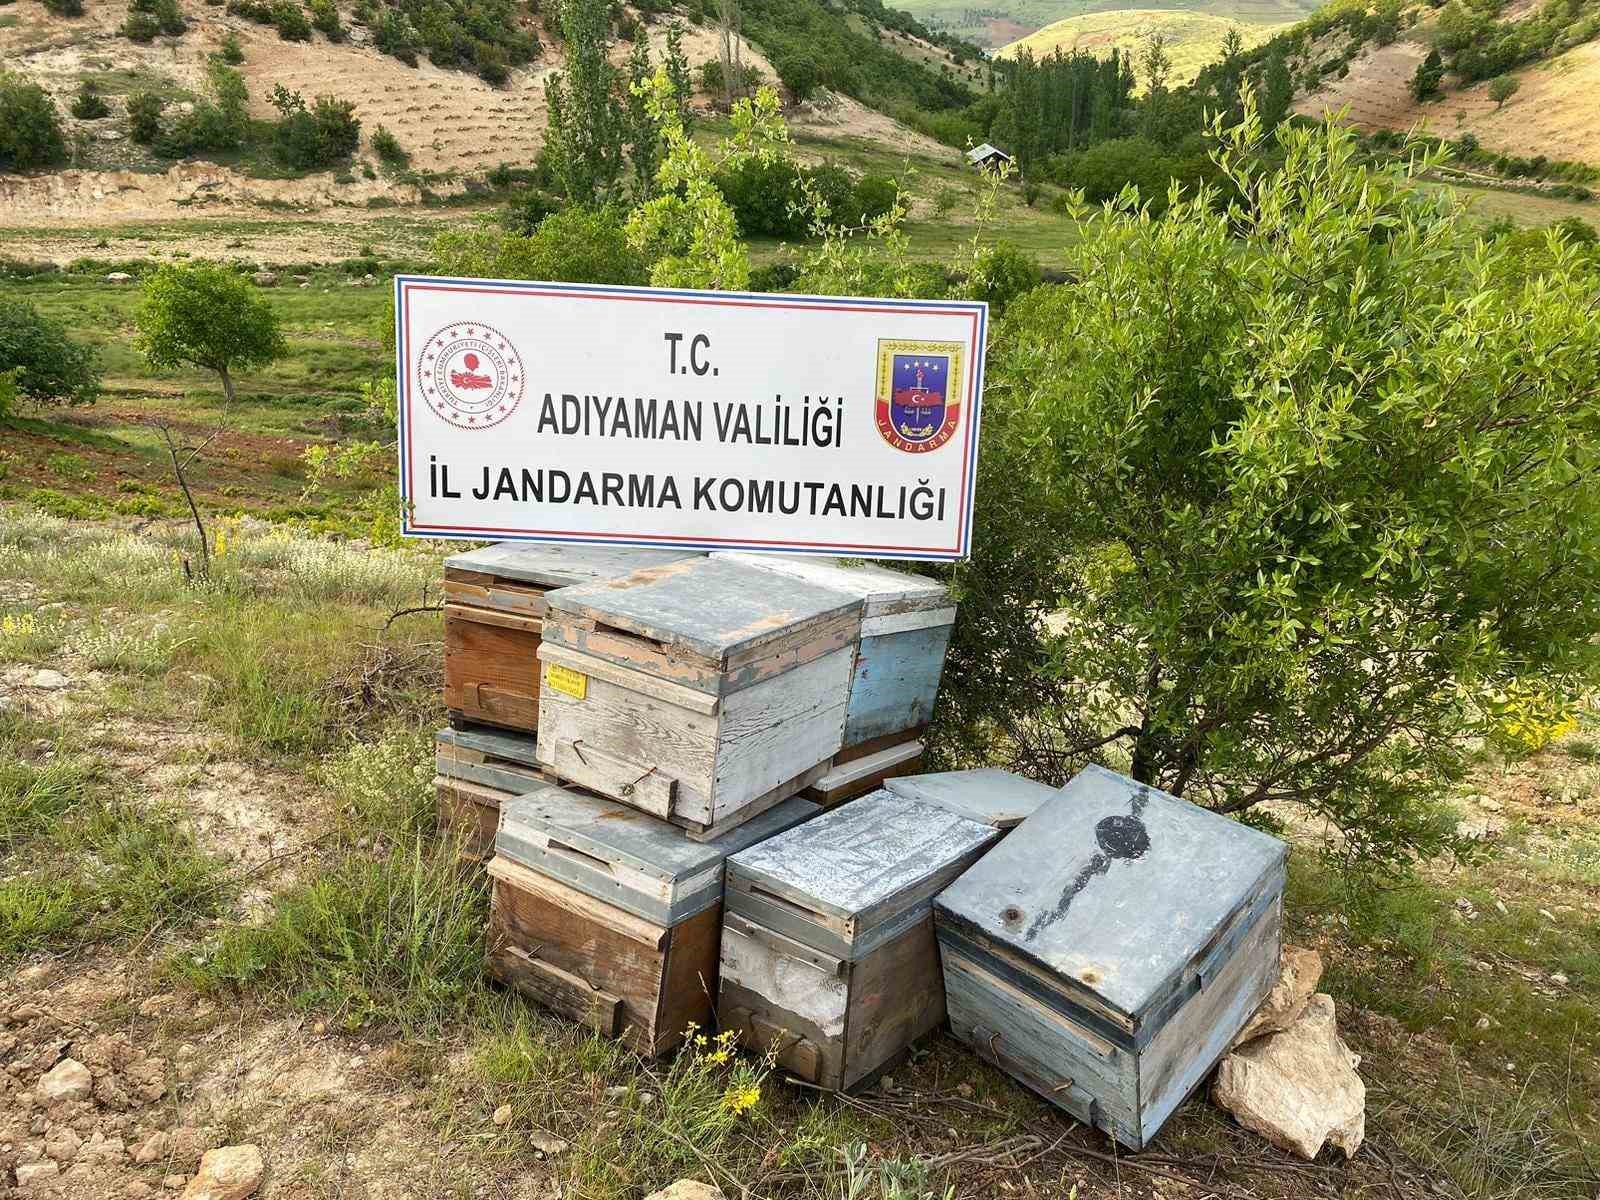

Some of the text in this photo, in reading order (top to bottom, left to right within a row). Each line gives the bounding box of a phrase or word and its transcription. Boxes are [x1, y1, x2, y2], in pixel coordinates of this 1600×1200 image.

[664, 332, 719, 376] T.C.
[537, 393, 843, 448] ADIYAMAN VALİLİĞİ
[878, 419, 956, 452] JANDARMA
[429, 455, 946, 521] İL JANDARMA KOMUTANLIĞI
